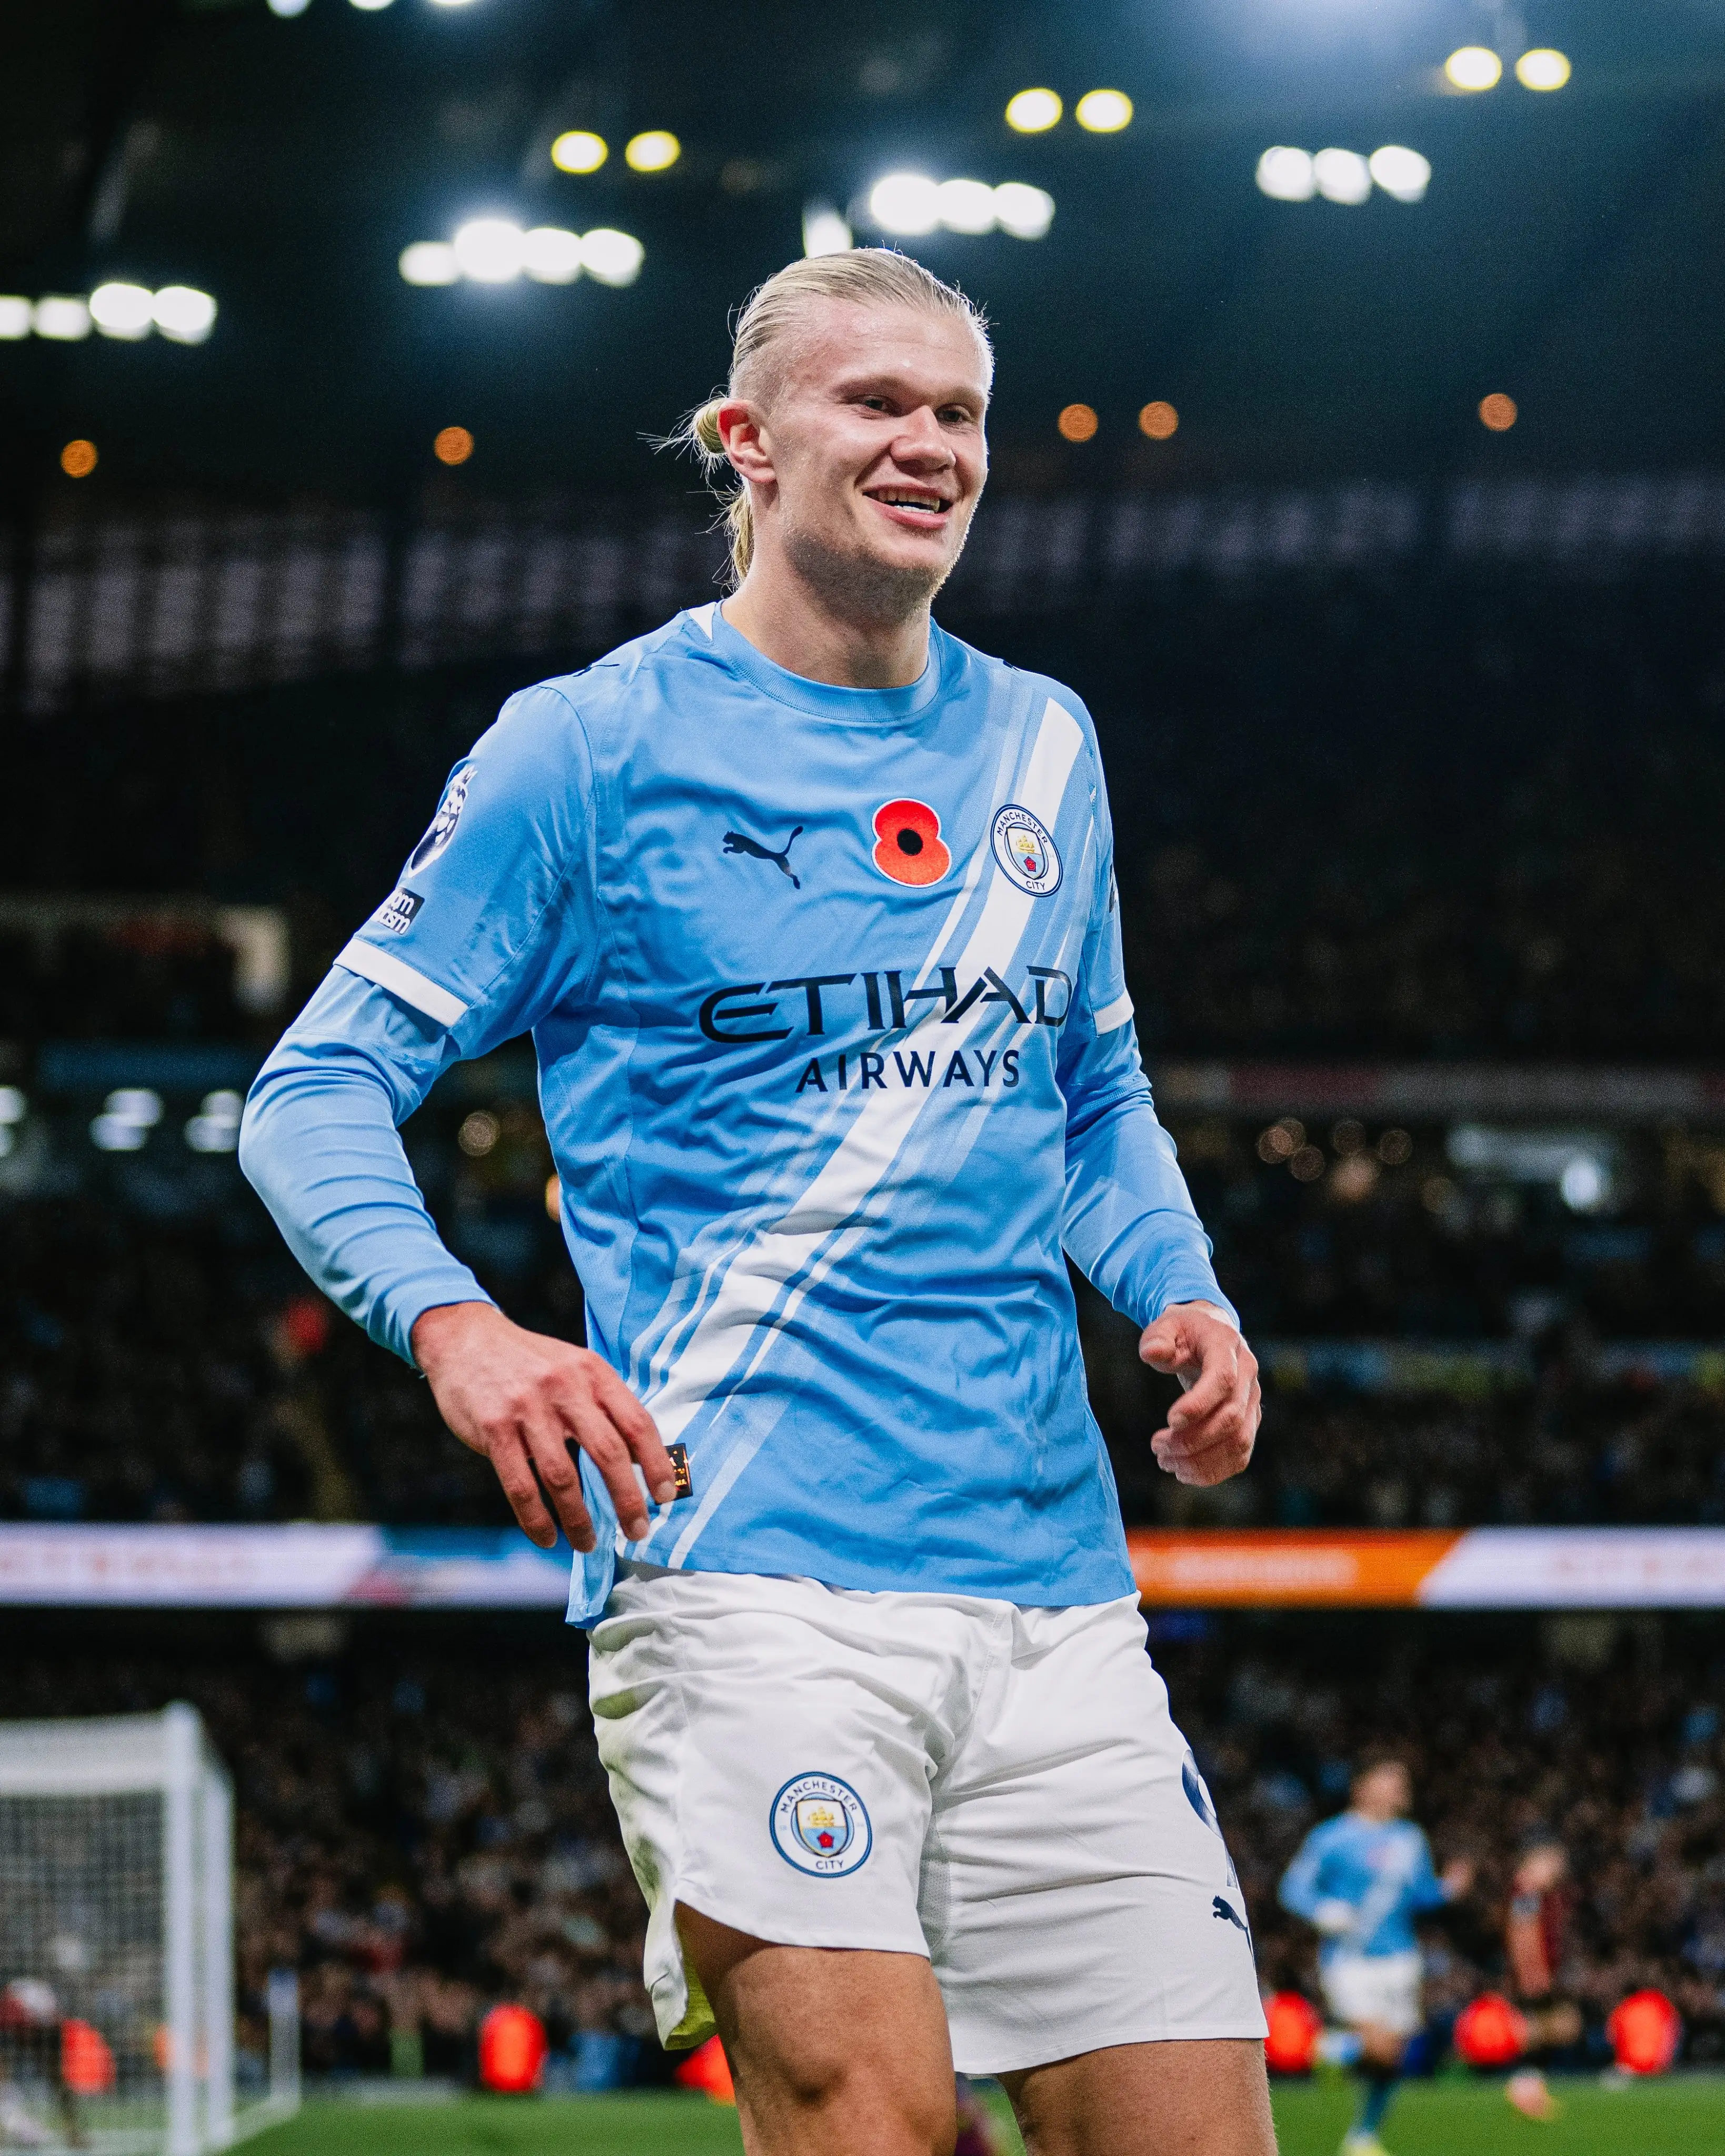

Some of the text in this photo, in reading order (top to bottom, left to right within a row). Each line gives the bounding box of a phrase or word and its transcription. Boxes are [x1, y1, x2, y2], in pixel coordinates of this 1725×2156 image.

[996, 811, 1048, 845] MANCHESTER
[1025, 880, 1045, 891] CITY
[698, 965, 1072, 1044] ETIHAD
[795, 1049, 1020, 1093] AIRWAYS
[781, 1780, 857, 1813] MANCHESTER
[815, 1859, 844, 1870] CITY
